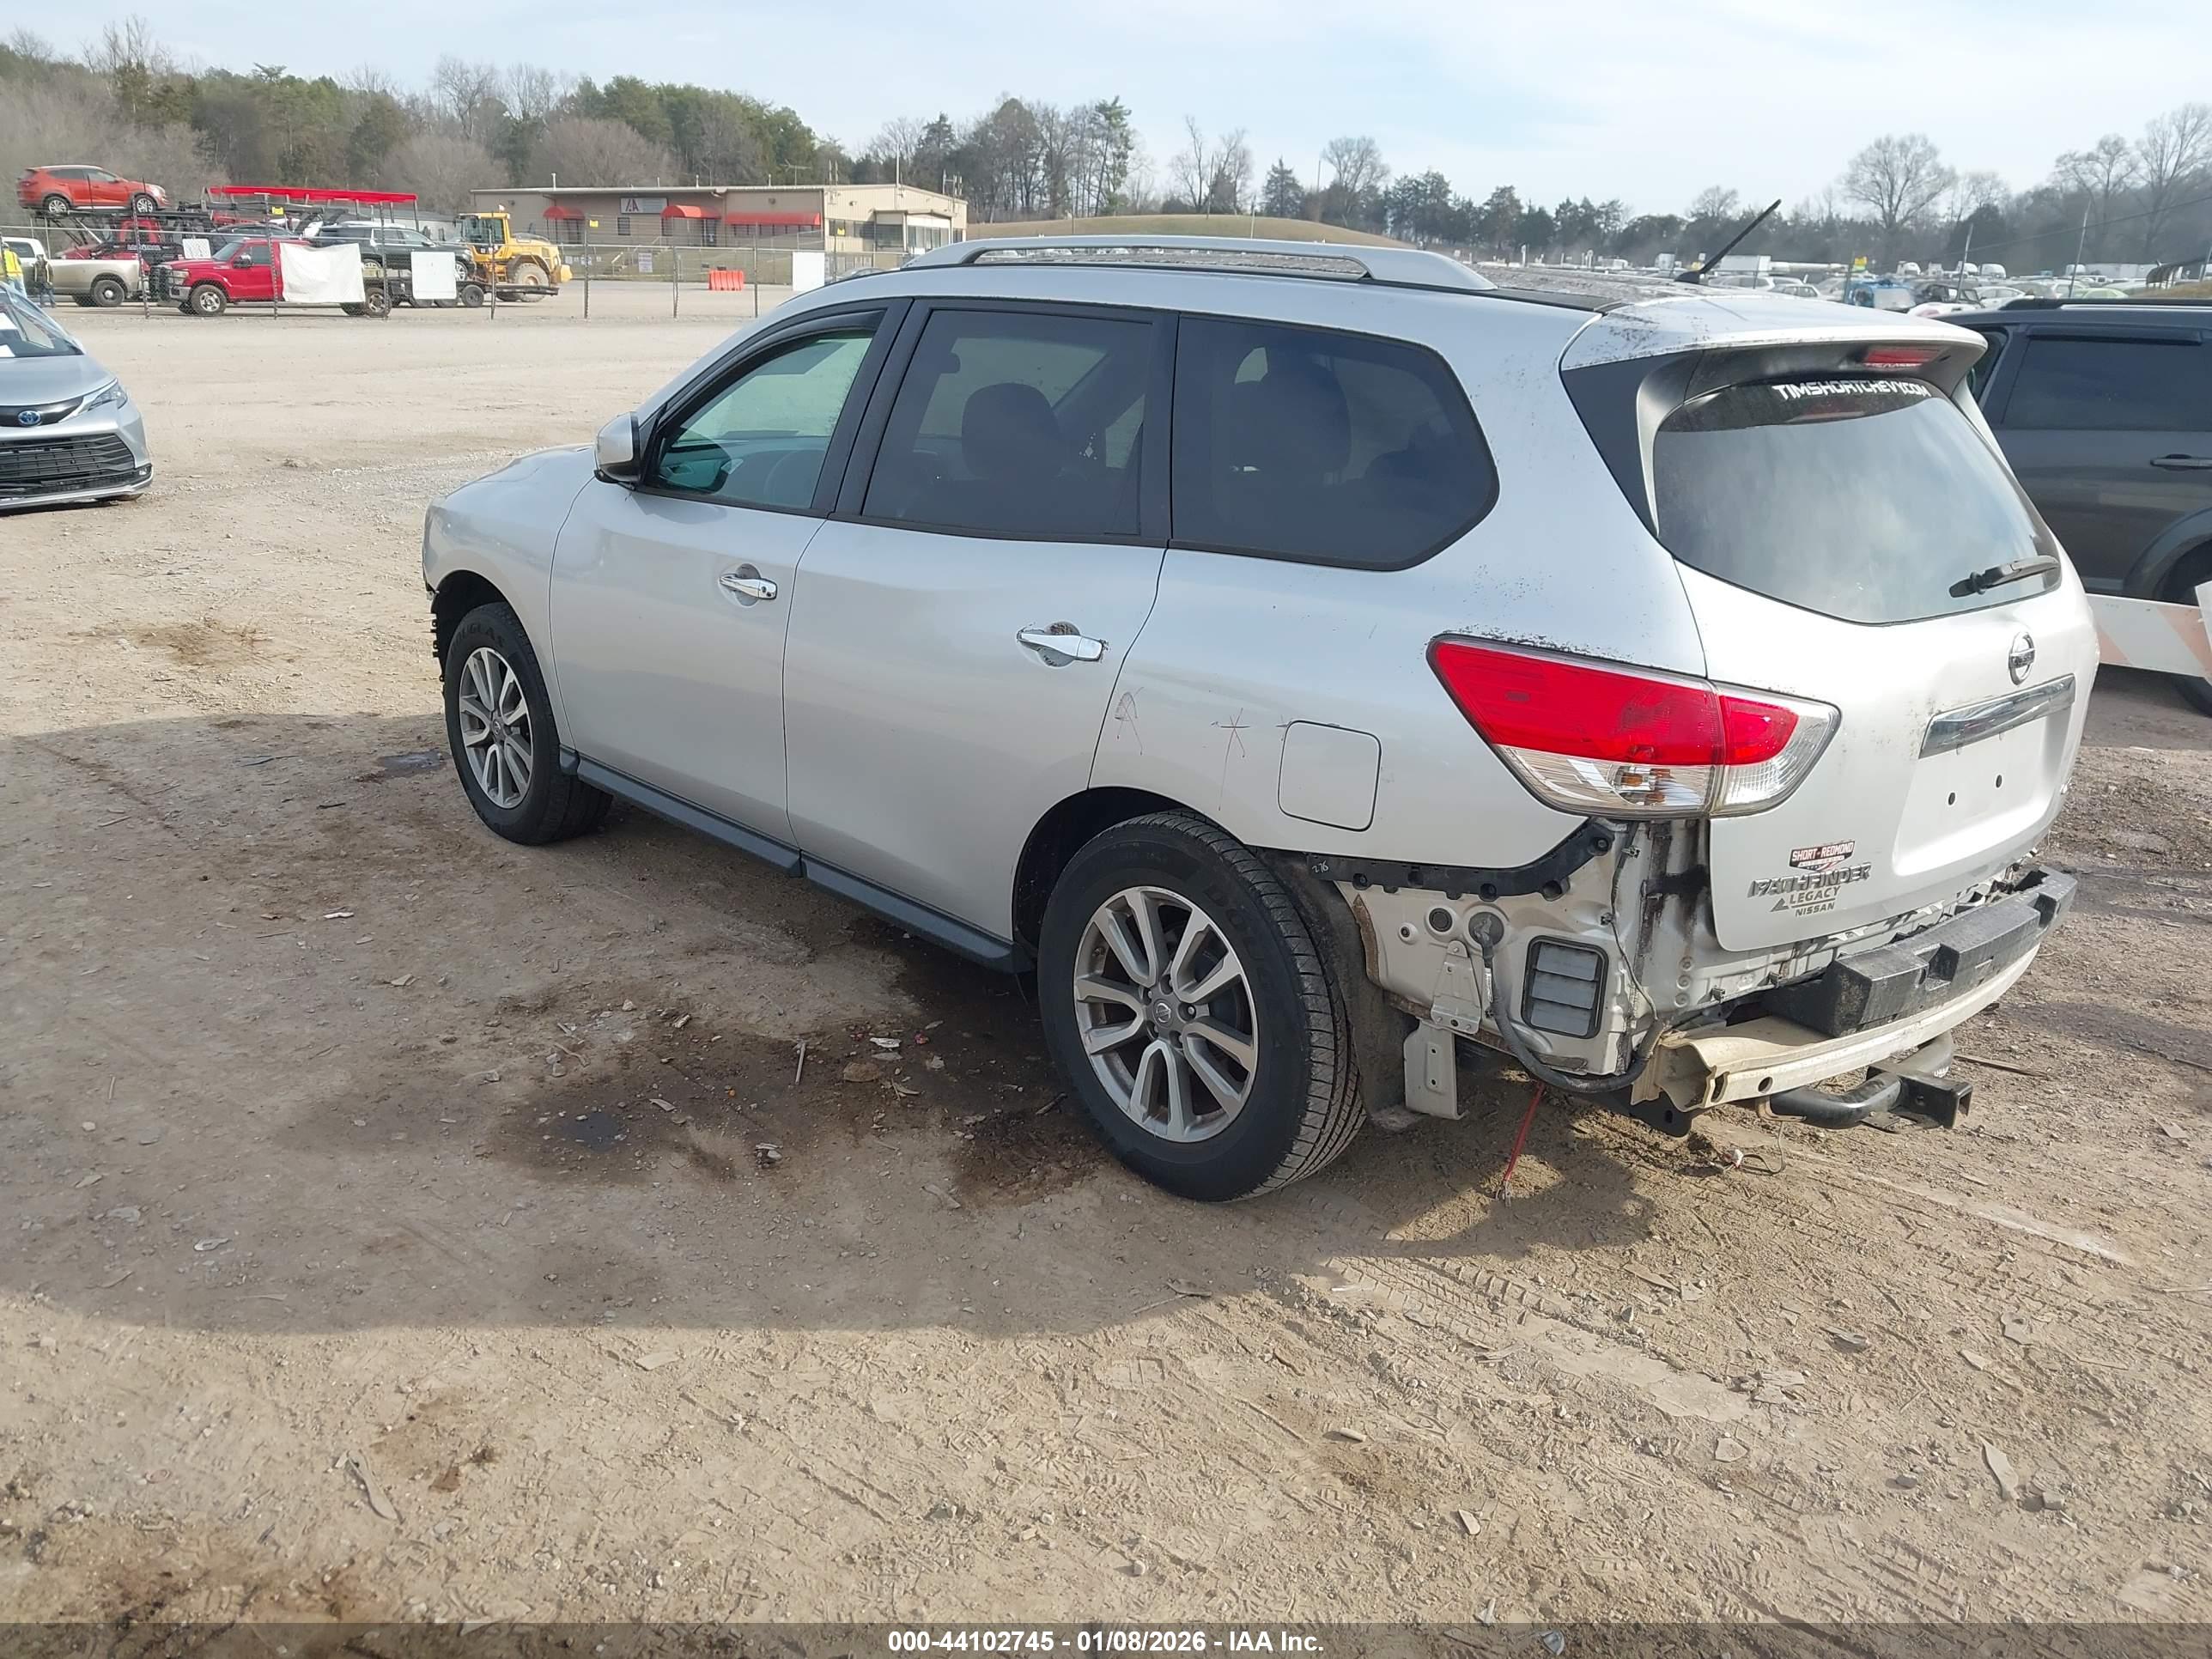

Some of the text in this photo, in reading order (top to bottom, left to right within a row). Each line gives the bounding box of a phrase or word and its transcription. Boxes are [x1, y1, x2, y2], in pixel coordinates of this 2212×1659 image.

[1791, 848, 1819, 862] SHORT
[1820, 842, 1854, 858] REDMOND
[1747, 861, 1872, 898] PATHFINDER
[1790, 885, 1841, 904] LEGACY
[1796, 902, 1835, 917] NISSAN
